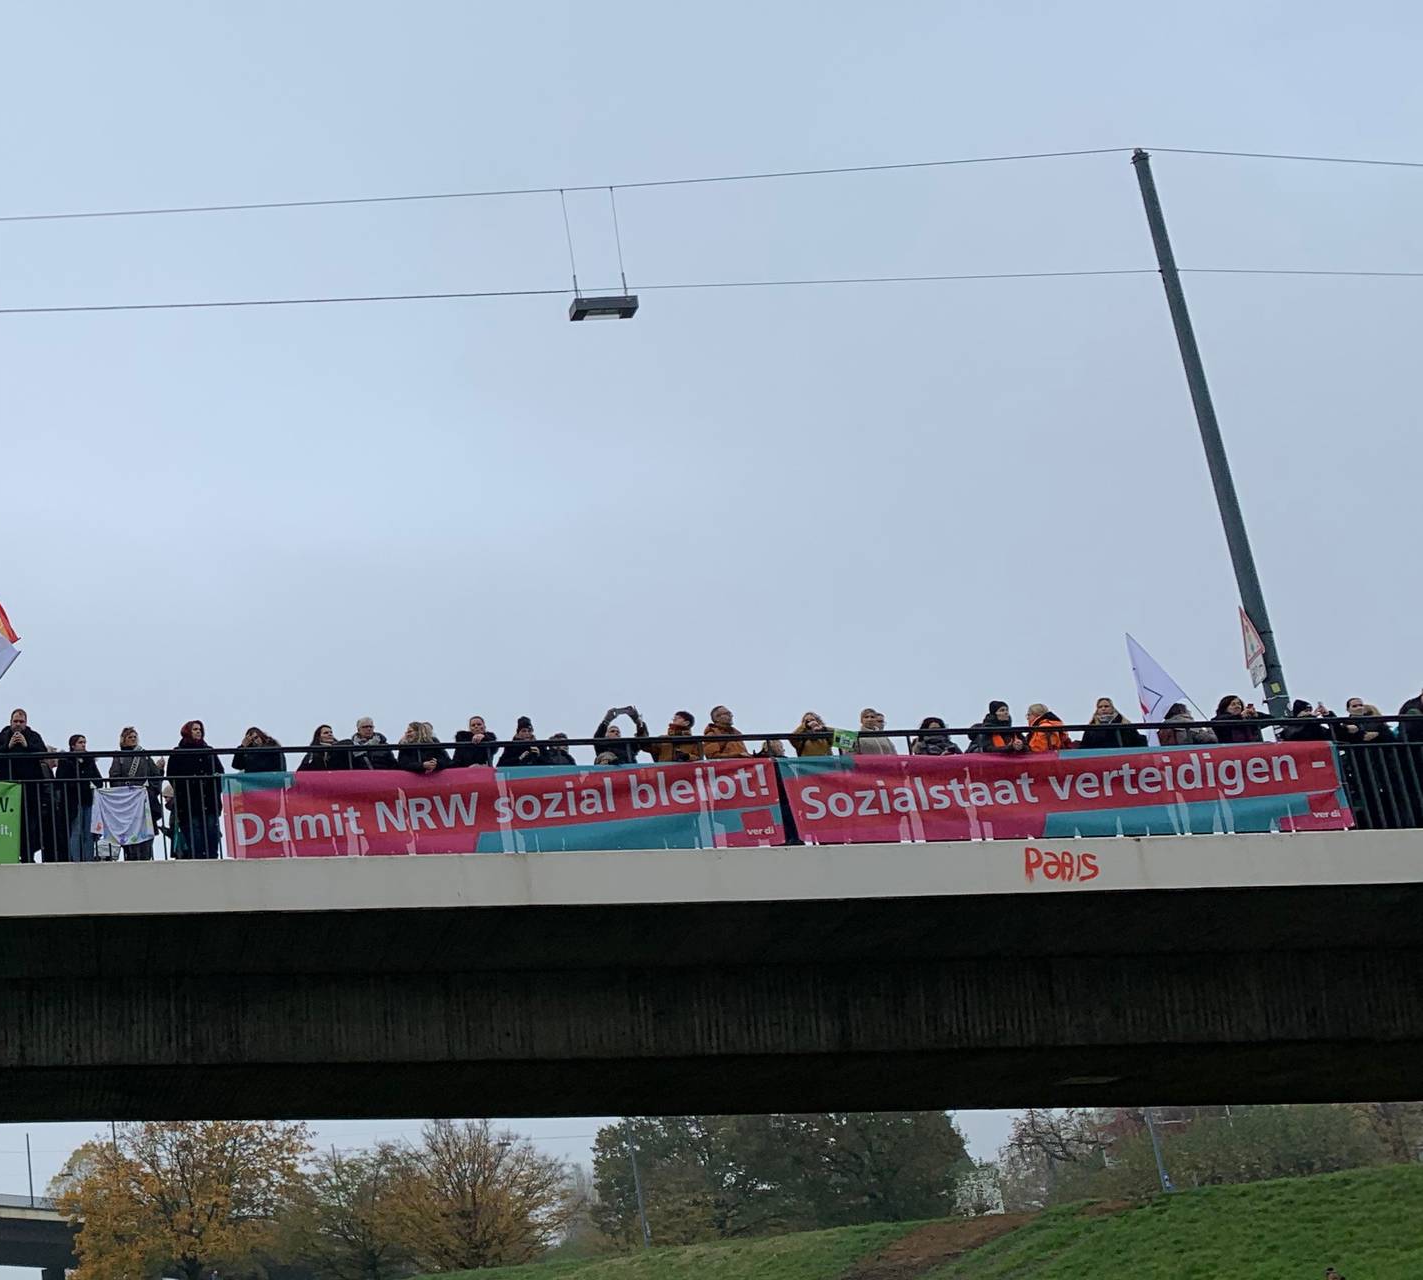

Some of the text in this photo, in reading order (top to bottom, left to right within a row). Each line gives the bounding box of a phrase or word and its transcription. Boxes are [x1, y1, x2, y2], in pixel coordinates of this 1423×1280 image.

[234, 764, 769, 846] Damit NRW sozial bleibt!
[801, 772, 1039, 820] Sozialstaat
[1048, 752, 1299, 801] verteidigen
